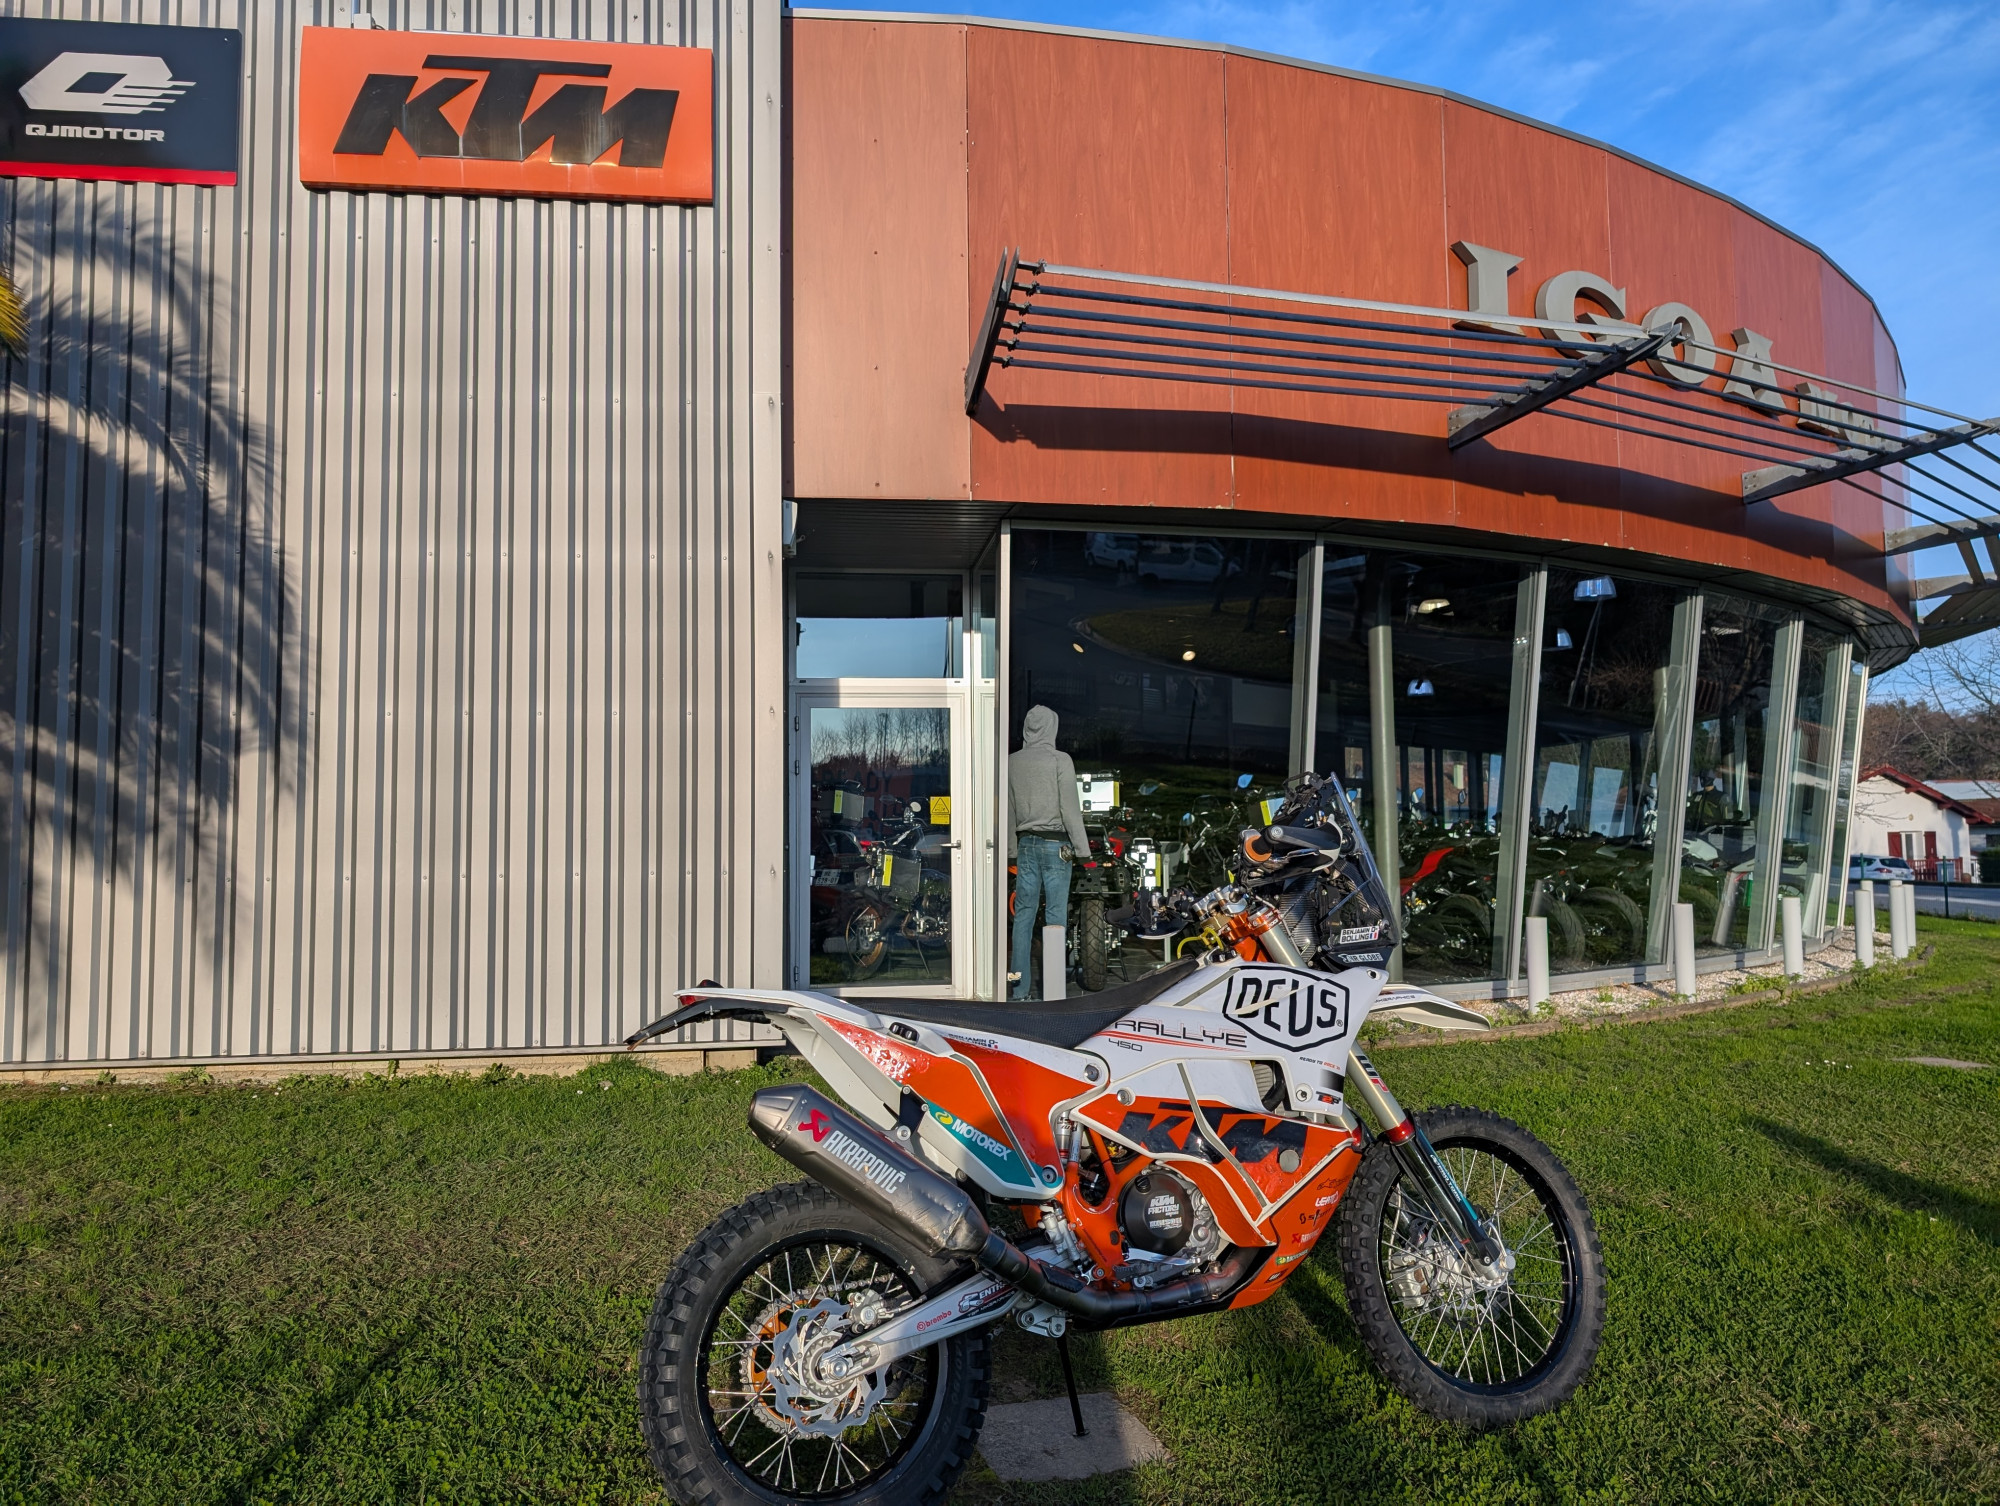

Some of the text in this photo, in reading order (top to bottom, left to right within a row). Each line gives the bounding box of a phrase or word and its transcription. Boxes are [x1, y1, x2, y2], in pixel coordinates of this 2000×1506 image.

[332, 55, 680, 168] KTM
[25, 123, 165, 142] QJMOTOR
[1450, 240, 1787, 418] IGOA
[1341, 933, 1370, 942] BOLLING
[1342, 927, 1370, 936] BENJAMIN
[1235, 977, 1338, 1037] DEUS
[1108, 1038, 1143, 1052] 450
[1114, 1018, 1248, 1048] RALLYE
[951, 1118, 1012, 1162] MOTOREX
[1118, 1101, 1309, 1165] KTM
[822, 1130, 907, 1195] AKRAPOVIČ
[1147, 1203, 1180, 1215] FACTORY
[1150, 1194, 1175, 1207] KTM
[925, 1310, 952, 1328] brembo
